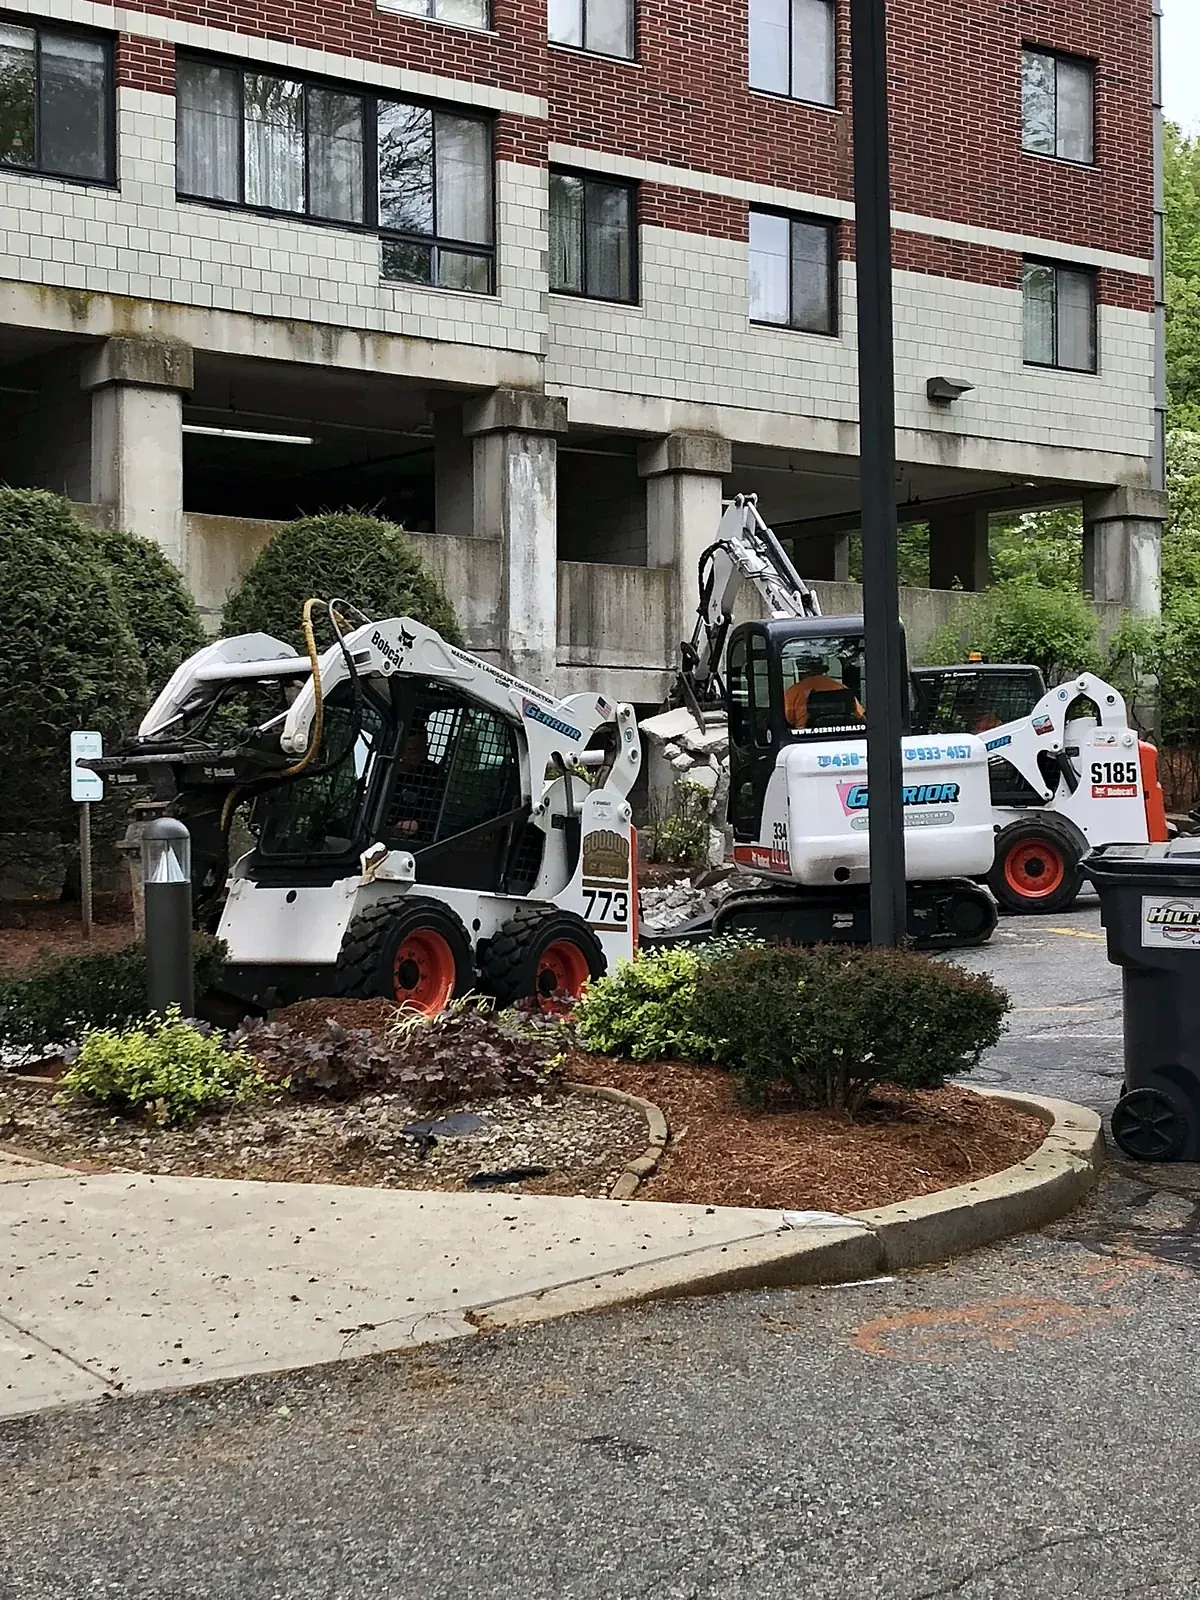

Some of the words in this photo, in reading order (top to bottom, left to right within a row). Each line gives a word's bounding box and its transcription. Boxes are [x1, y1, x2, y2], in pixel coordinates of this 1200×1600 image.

[371, 630, 404, 669] Bobcat
[482, 665, 514, 685] LANDSCAPE
[513, 681, 554, 705] CONSTRUCTION
[524, 703, 582, 741] GERRIOR
[791, 724, 867, 736] WWW.GERRIORMASO
[832, 752, 866, 767] 438-
[917, 745, 971, 760] 933-4157
[1091, 762, 1137, 783] S185
[846, 783, 960, 809] GRIOR
[1107, 787, 1134, 796] Bobcat
[582, 889, 628, 921] 773
[1147, 907, 1200, 925] HILT
